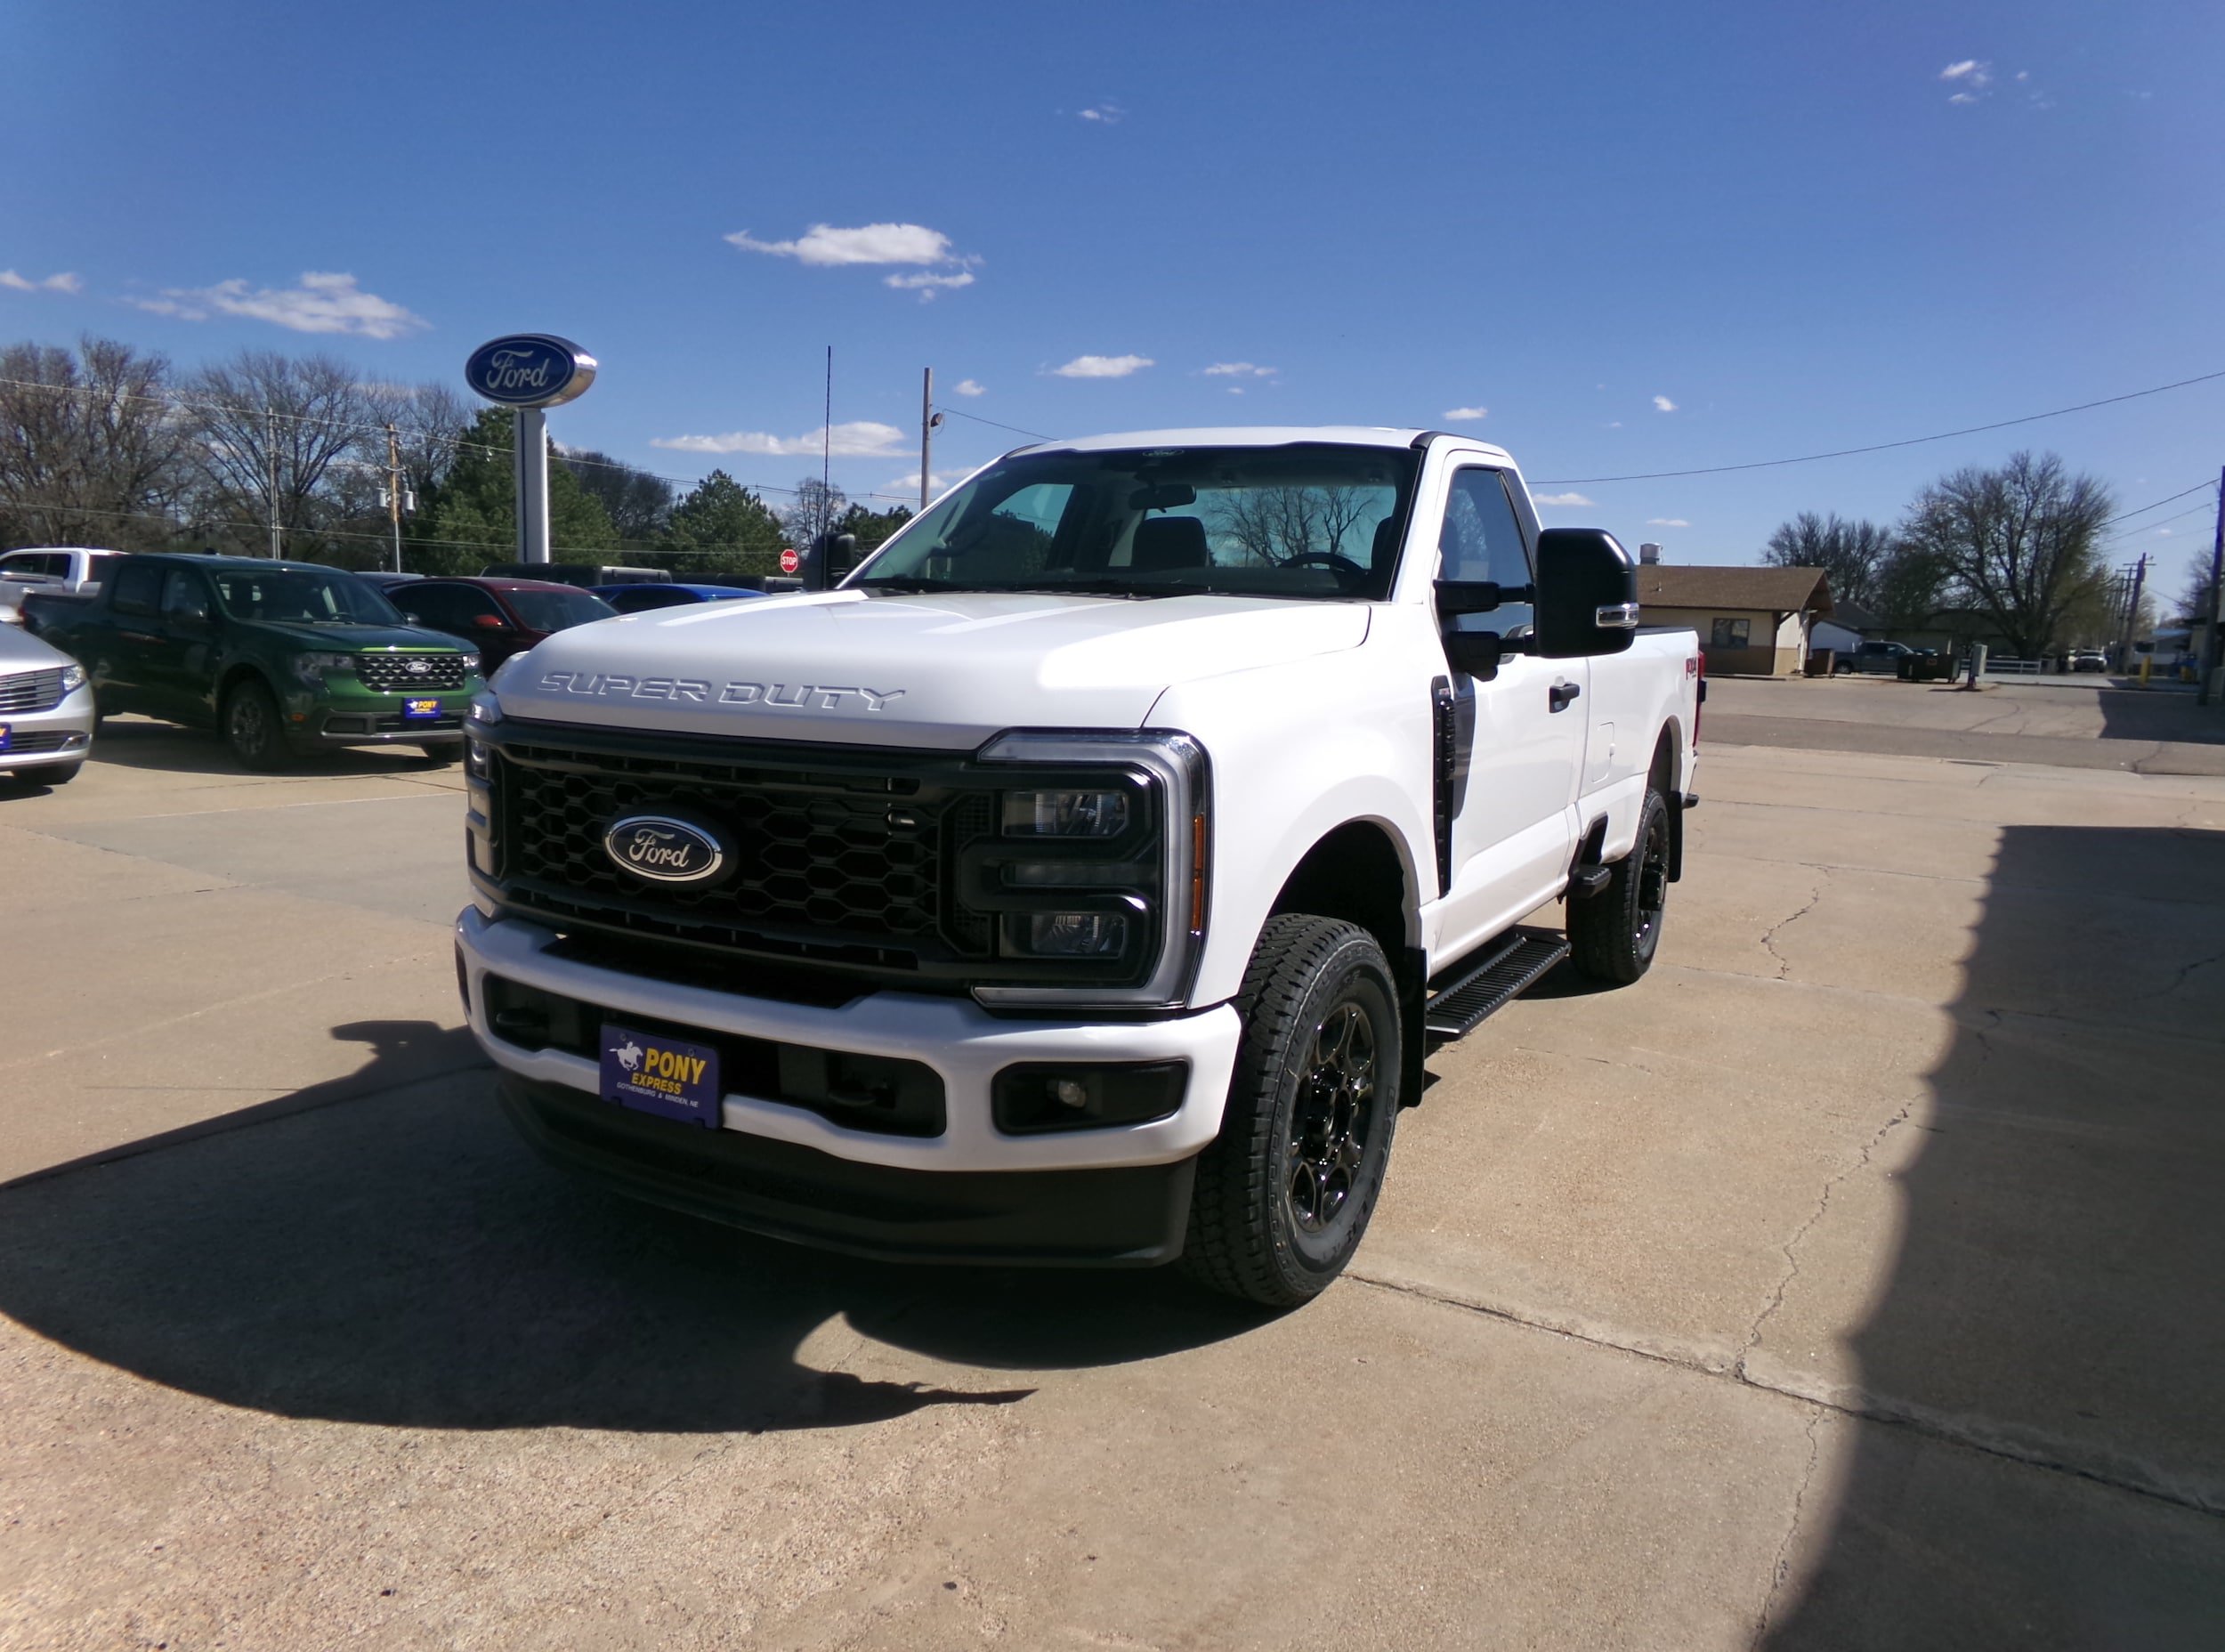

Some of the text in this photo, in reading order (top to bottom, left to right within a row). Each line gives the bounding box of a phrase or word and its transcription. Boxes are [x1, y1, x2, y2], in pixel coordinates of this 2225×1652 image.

[486, 350, 550, 388] Ford
[782, 555, 797, 565] STOP
[418, 700, 437, 709] PONY
[538, 671, 906, 711] SUPER DUTY
[629, 829, 691, 867] Ford
[644, 1048, 706, 1085] PONY
[617, 1082, 656, 1097] GOTHENBURG
[631, 1073, 683, 1095] EXPRESS
